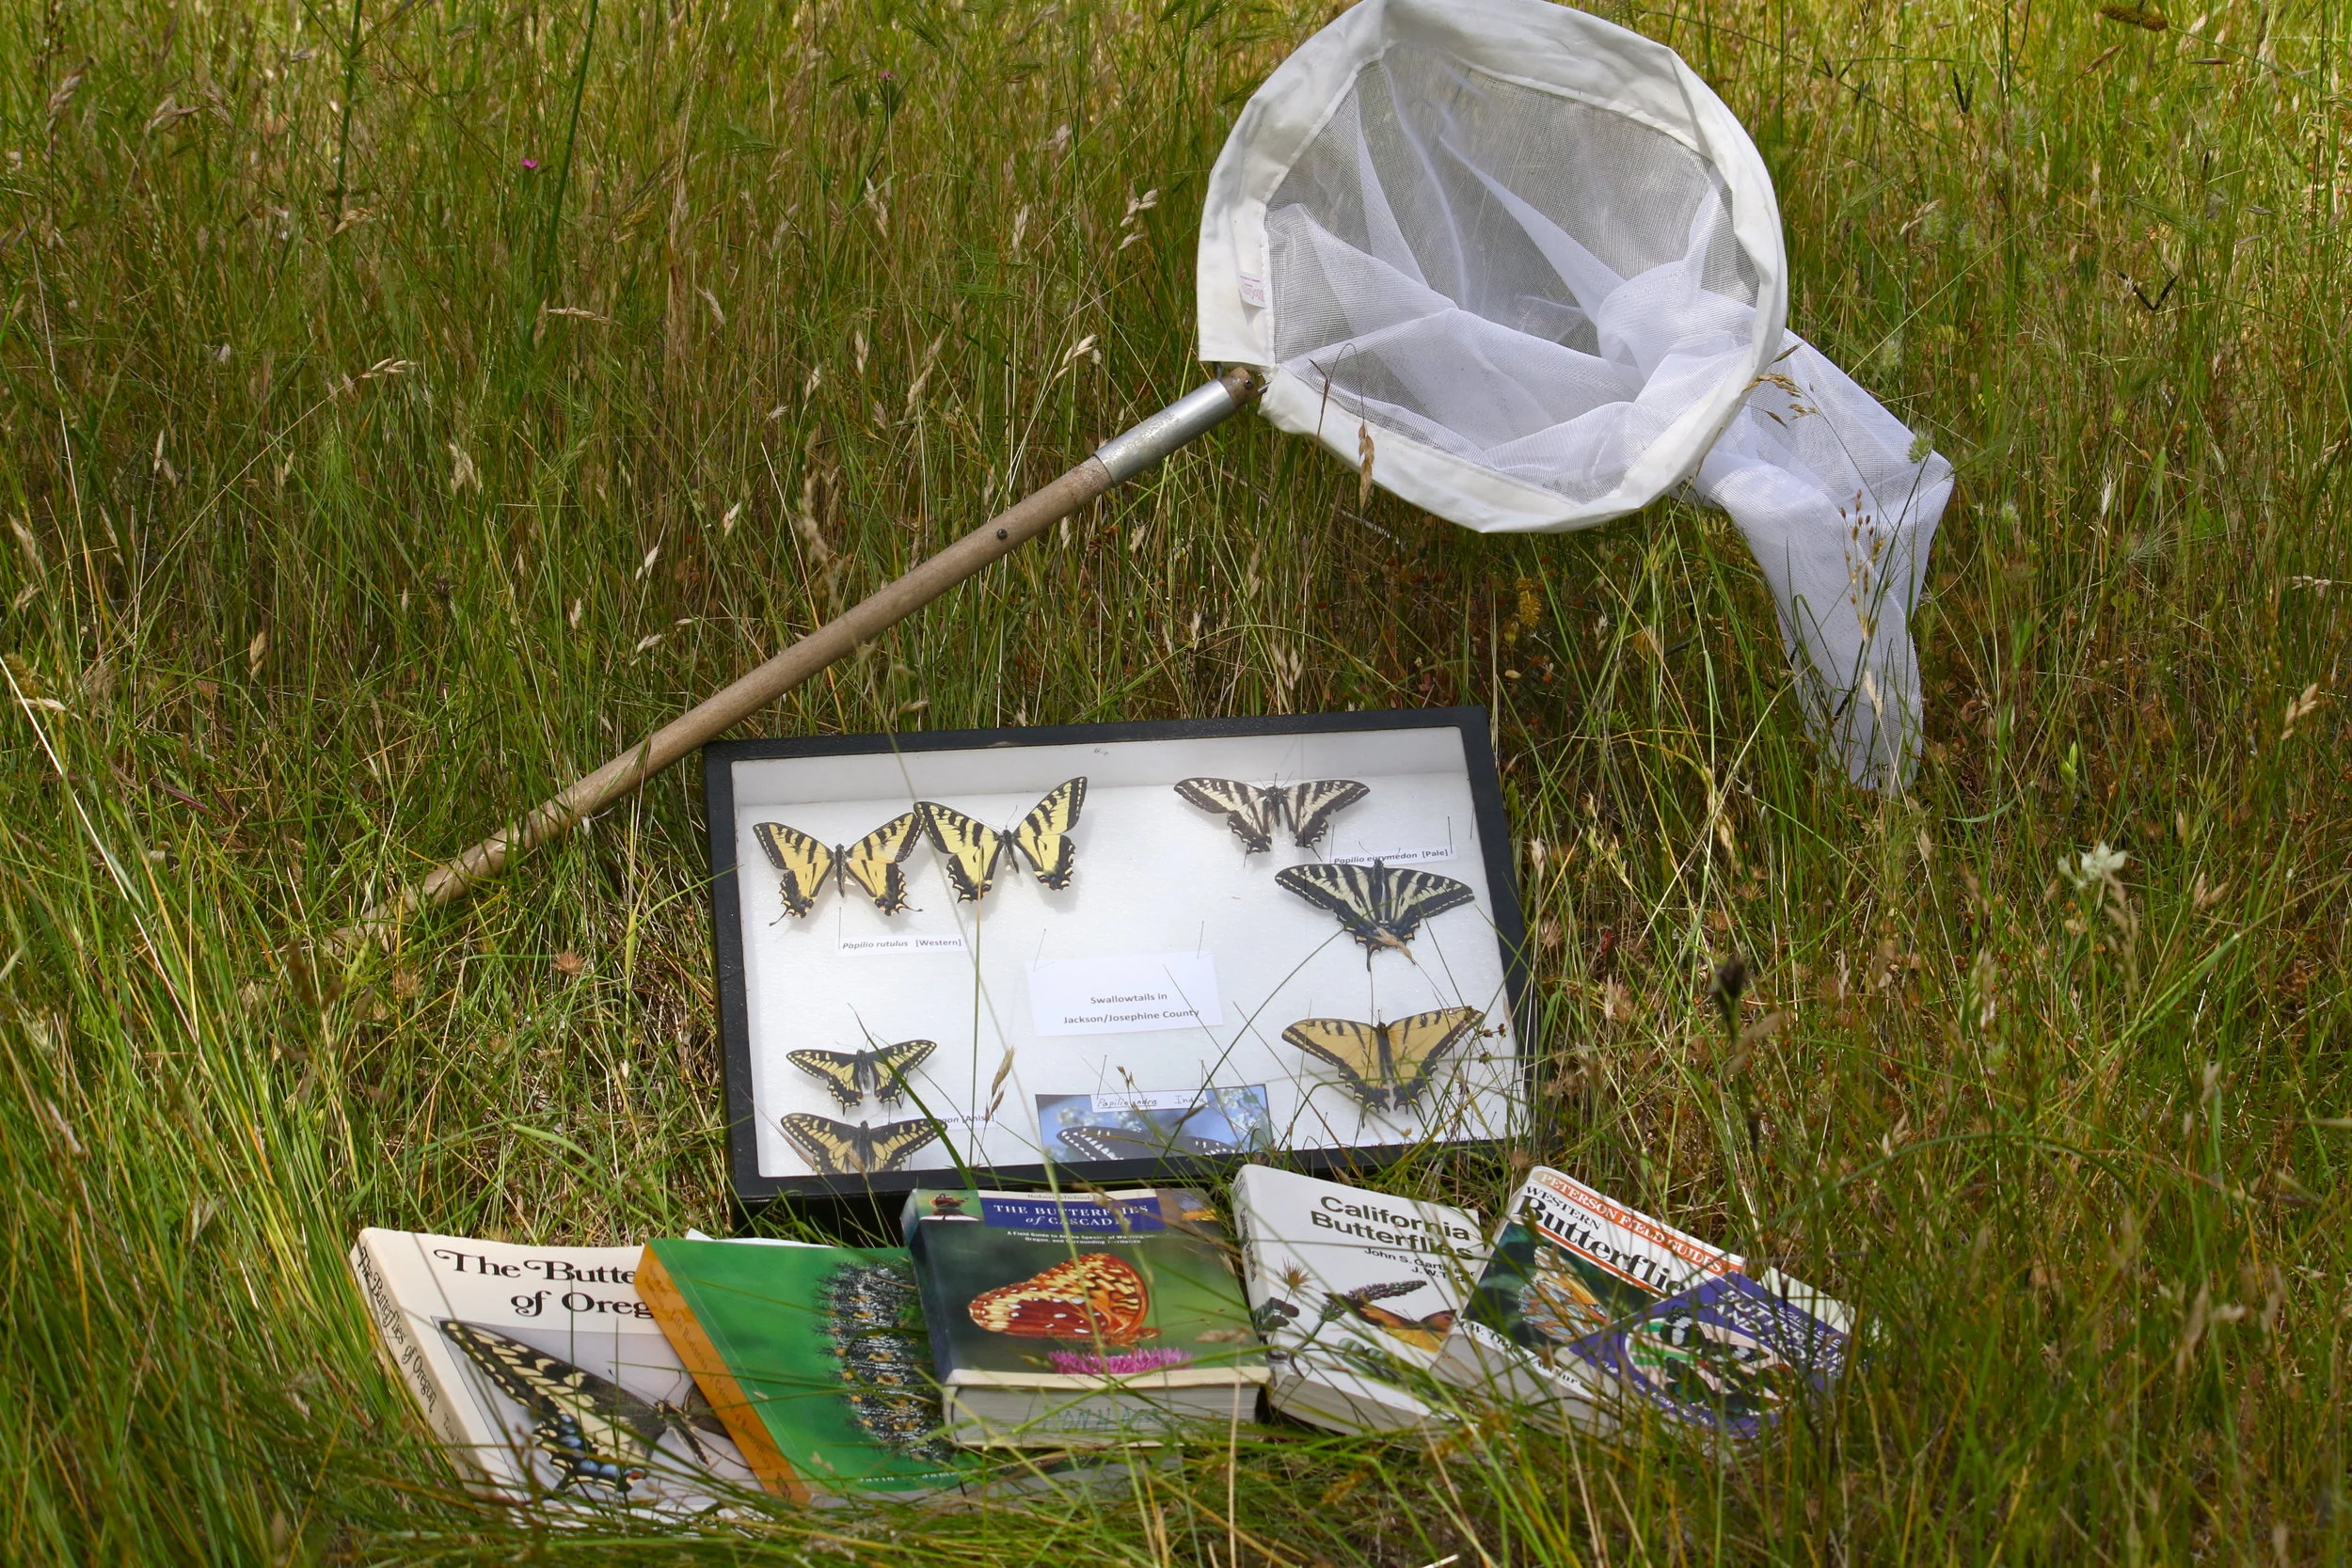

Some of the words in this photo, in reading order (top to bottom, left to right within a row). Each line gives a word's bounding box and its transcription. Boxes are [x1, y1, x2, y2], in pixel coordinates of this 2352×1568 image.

[1334, 855, 1365, 865] Papilio
[1367, 851, 1418, 863] eurymedon
[1422, 848, 1449, 859] [Pale]
[843, 941, 874, 950] Papilio
[877, 940, 909, 948] rutulus
[915, 939, 961, 948] [Western]
[1090, 992, 1155, 1005] Swallowtails
[1157, 992, 1168, 1001] in
[1063, 1012, 1159, 1024] Jackson/Josephine
[1162, 1008, 1200, 1020] County
[961, 1113, 995, 1124] [Anis]
[993, 1204, 1028, 1214] THE
[1035, 1204, 1149, 1217] BUTERFIES
[1320, 1196, 1470, 1241] California
[1526, 1185, 1600, 1230] WESTERN
[1025, 1215, 1044, 1226] of
[1540, 1174, 1618, 1221] PETERSON
[1619, 1213, 1666, 1243] FIELD
[1668, 1238, 1723, 1273] GUIDES
[1311, 1211, 1473, 1260] Butterflies
[434, 1249, 521, 1278] The
[1364, 1247, 1396, 1260] John
[1414, 1259, 1447, 1271] Gart
[511, 1290, 552, 1317] of
[357, 1244, 373, 1284] The
[370, 1271, 405, 1345] Butterflies
[402, 1342, 416, 1364] of
[412, 1355, 437, 1413] Oregon
